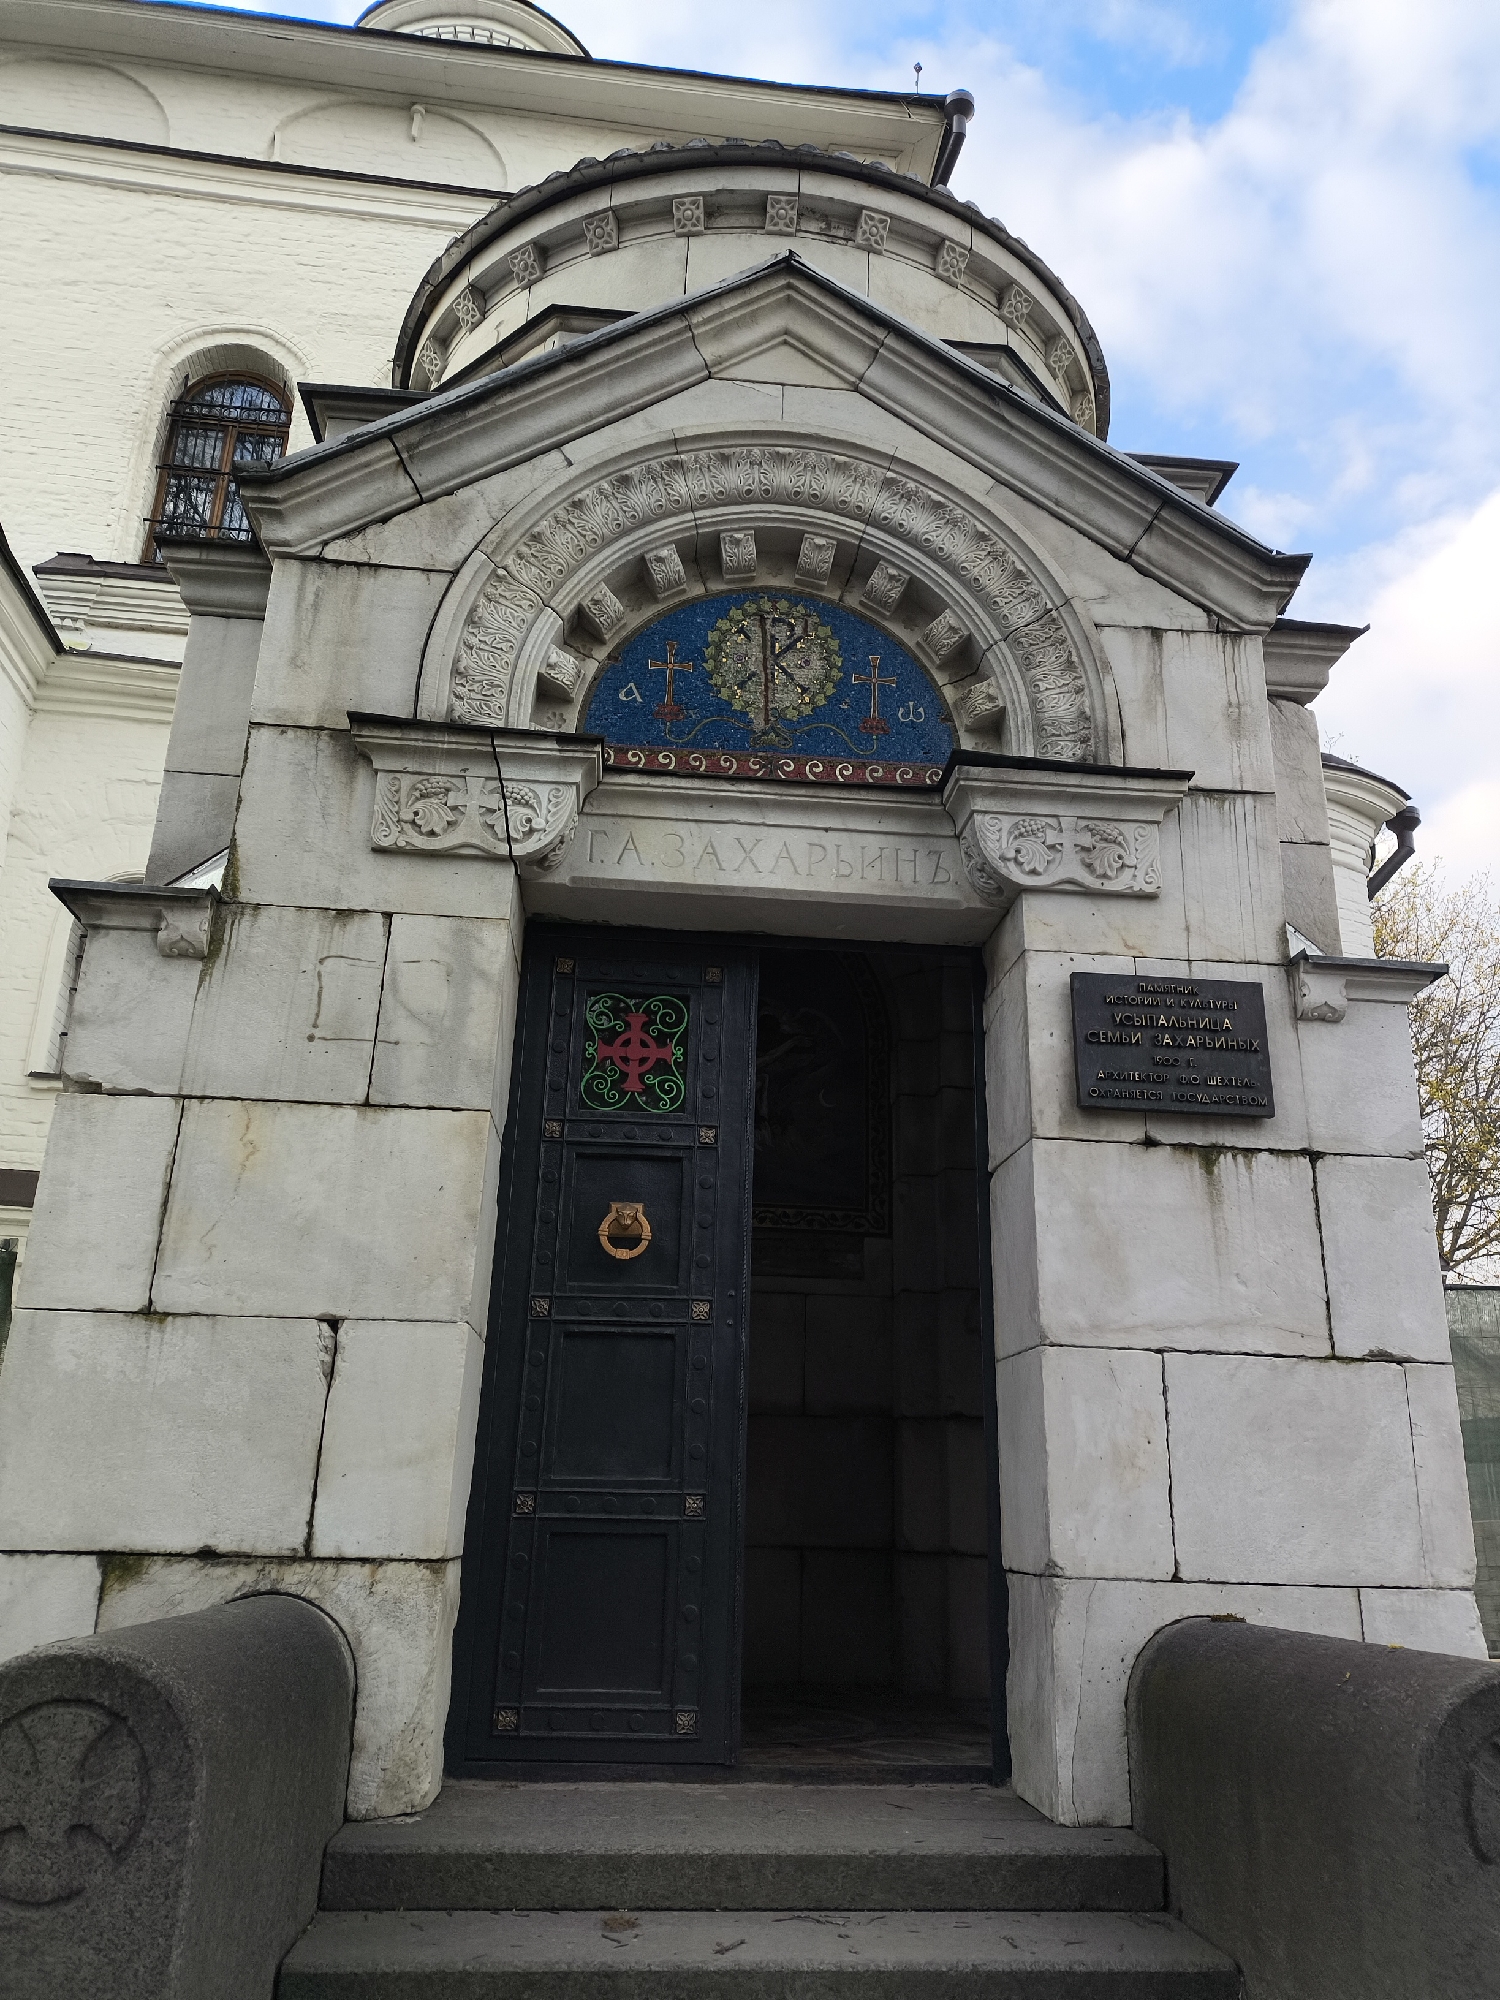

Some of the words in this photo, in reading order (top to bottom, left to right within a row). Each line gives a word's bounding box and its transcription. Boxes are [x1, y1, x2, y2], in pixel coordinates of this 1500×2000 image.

[1138, 982, 1199, 995] ПАМЯТНИК
[1105, 995, 1161, 1007] ИСТОРИИ
[1166, 997, 1175, 1007] И
[1180, 998, 1238, 1010] КУЛЬТУРЫ
[1113, 1012, 1233, 1031] УСЫПАЛЬНИЦА
[1087, 1030, 1143, 1044] СЕМЬИ
[1154, 1033, 1260, 1051] ЗАХАРЬИНЫХ
[1097, 1070, 1170, 1082] АРХИТЕКТОР
[1089, 1087, 1163, 1101] ОХРАНЯЕТСЯ
[1172, 1091, 1268, 1106] ГОСУДАРСТВОМ
